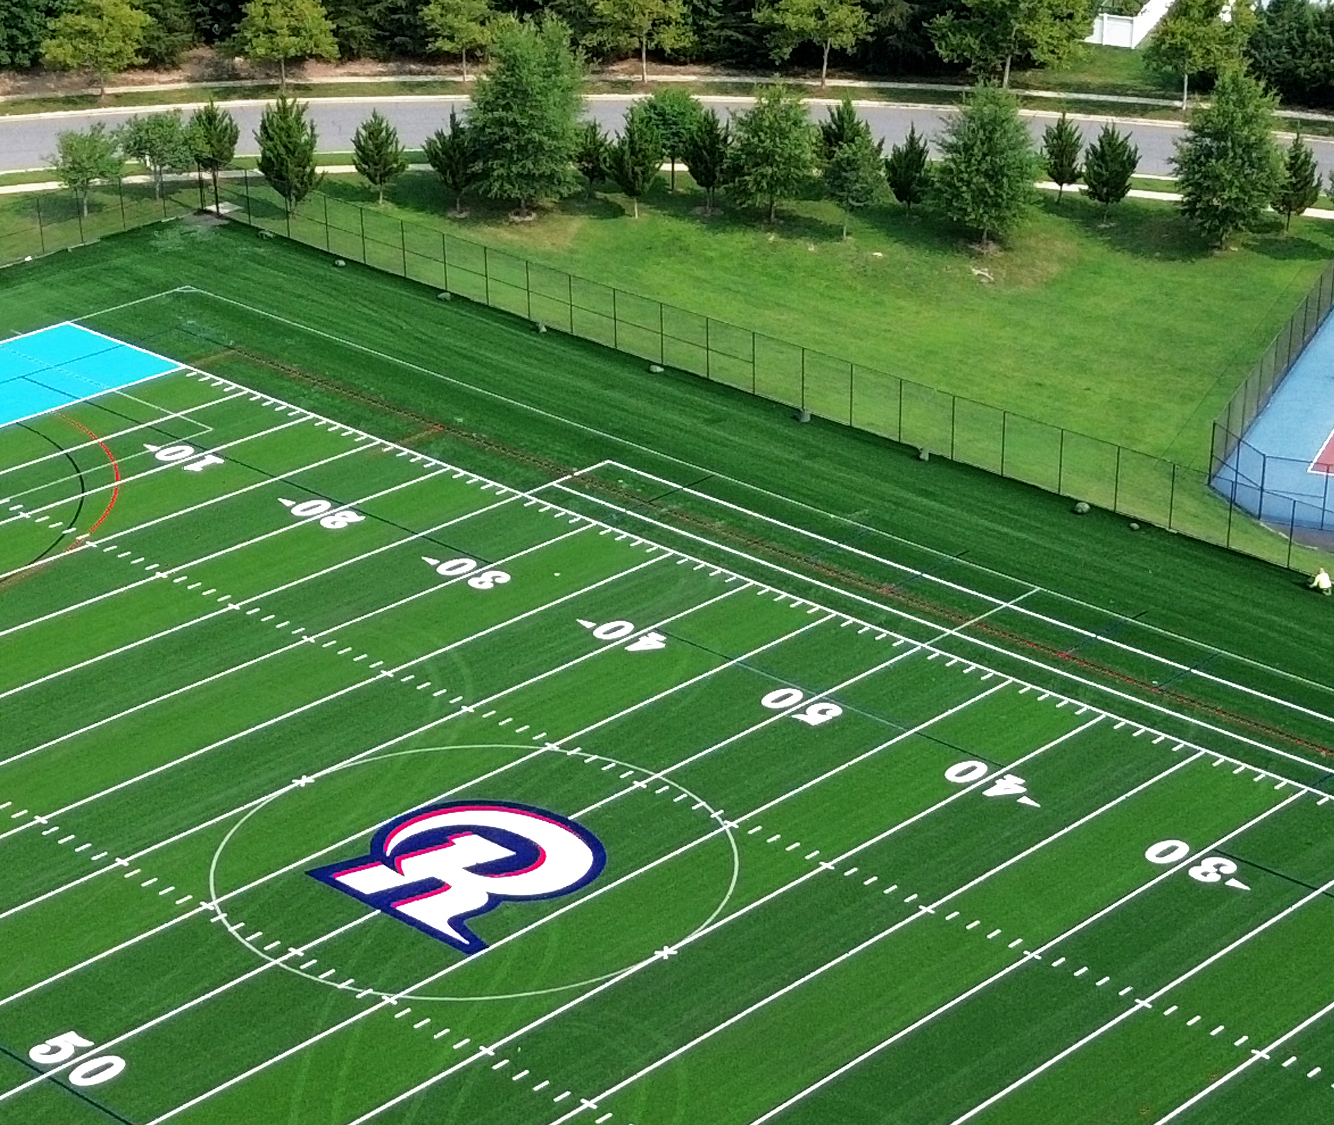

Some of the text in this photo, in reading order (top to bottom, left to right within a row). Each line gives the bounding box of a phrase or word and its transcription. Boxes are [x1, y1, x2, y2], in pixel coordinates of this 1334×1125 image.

[155, 443, 226, 470] 10
[292, 499, 365, 530] 20
[436, 557, 511, 589] 30
[591, 620, 667, 651] 40
[760, 688, 843, 725] 50
[943, 760, 1027, 796] 40
[1145, 839, 1237, 881] 30
[28, 1031, 126, 1086] 50
